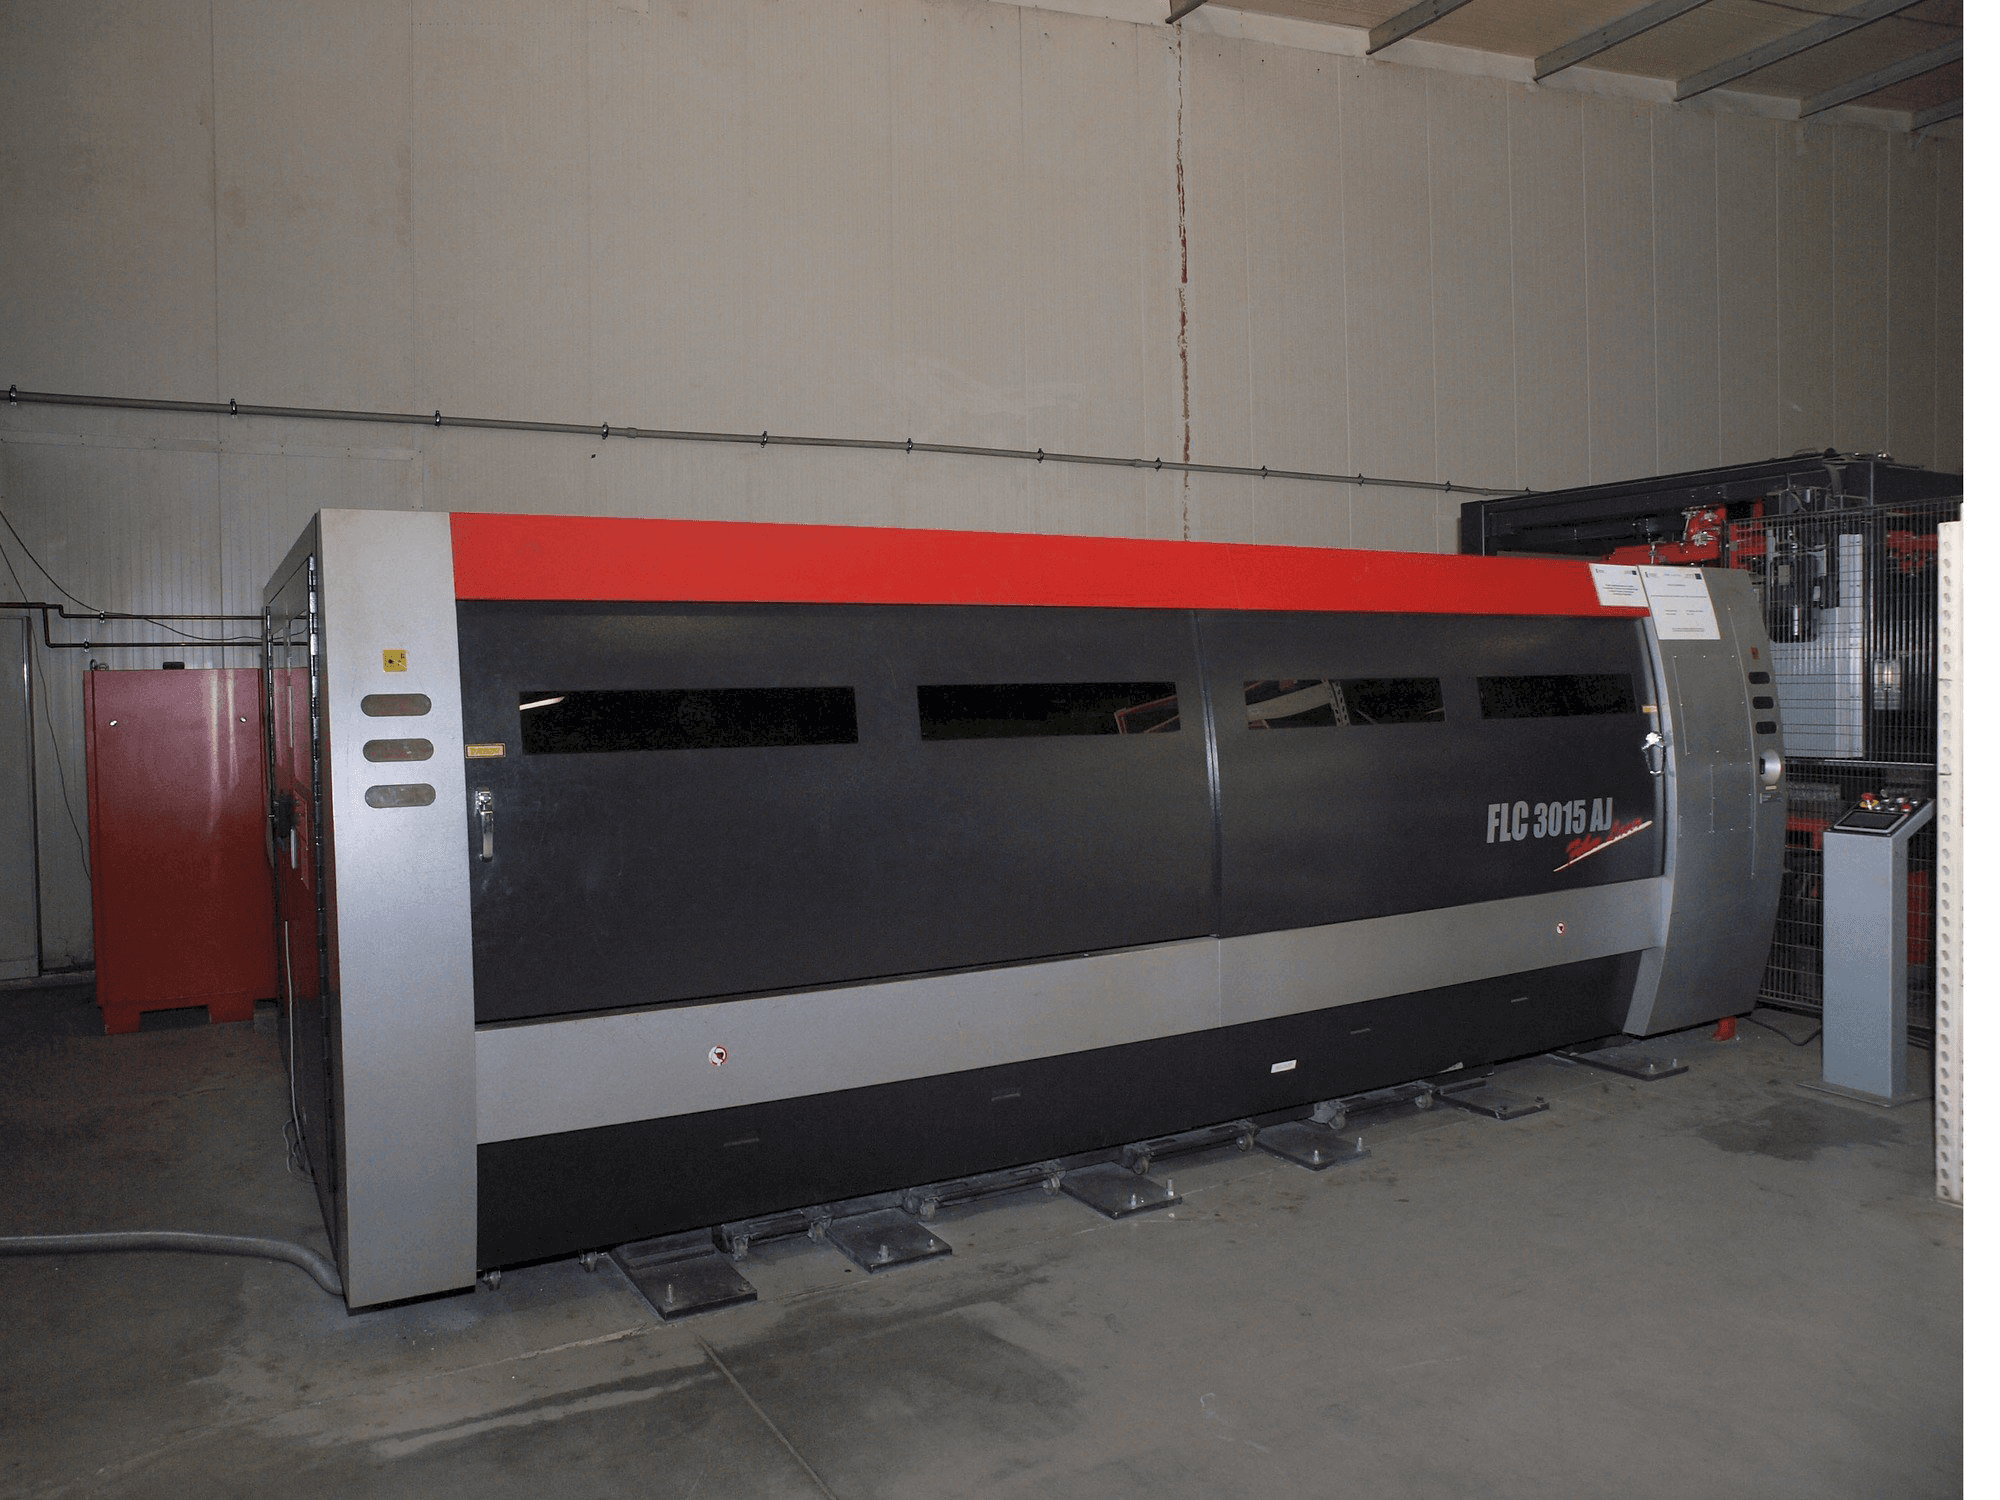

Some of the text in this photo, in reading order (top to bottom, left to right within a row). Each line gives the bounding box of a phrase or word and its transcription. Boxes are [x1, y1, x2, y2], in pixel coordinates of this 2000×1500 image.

[1486, 801, 1529, 843] FLC
[1533, 800, 1587, 838] 3015
[1589, 797, 1613, 832] AJ
